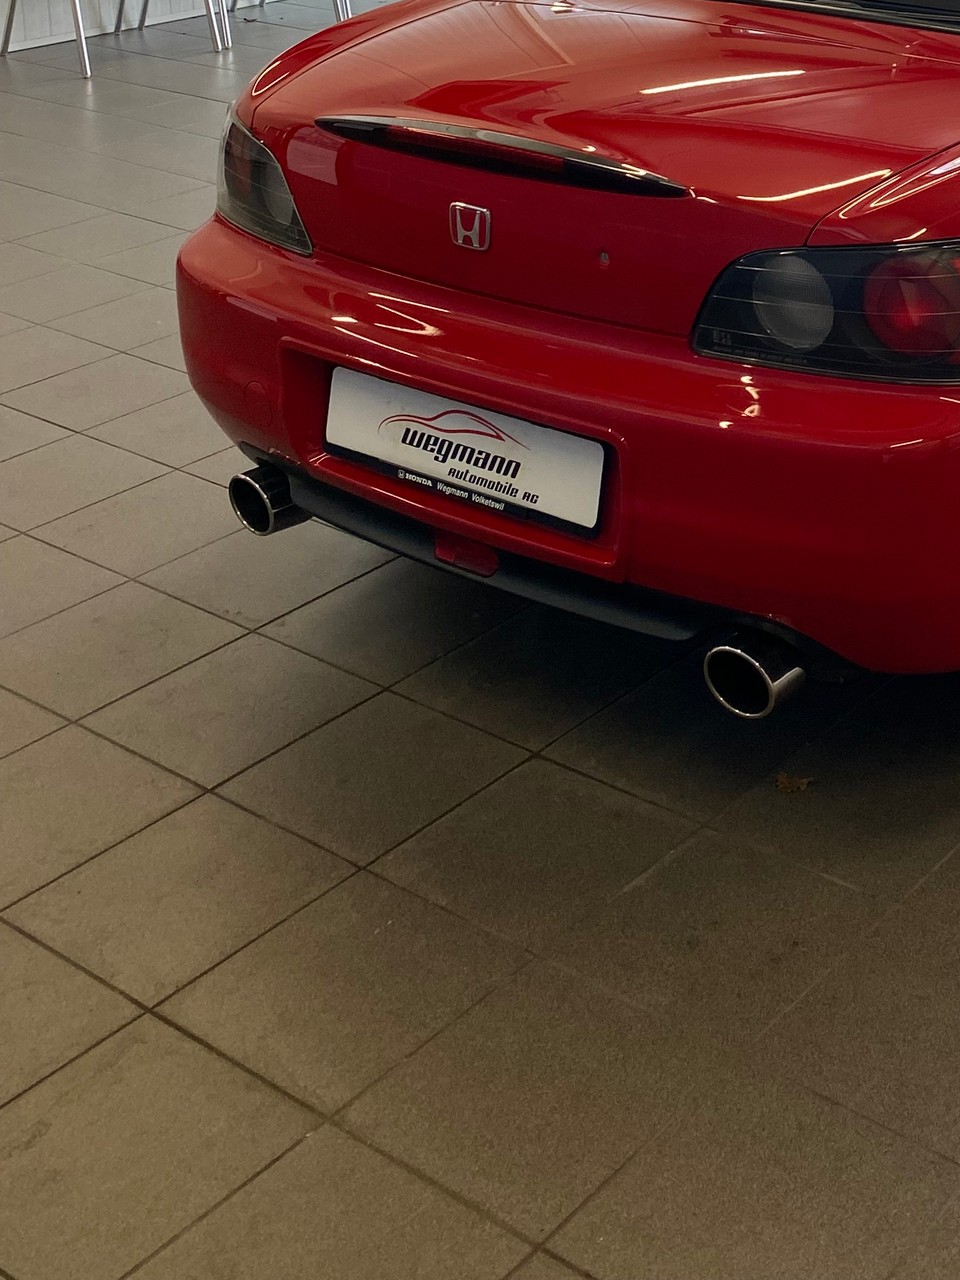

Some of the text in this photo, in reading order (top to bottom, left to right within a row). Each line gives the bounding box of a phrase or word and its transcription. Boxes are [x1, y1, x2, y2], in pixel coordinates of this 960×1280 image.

[401, 427, 521, 479] wegmann
[405, 473, 505, 511] HONDA Wegmann Volketswil
[522, 491, 539, 504] AG
